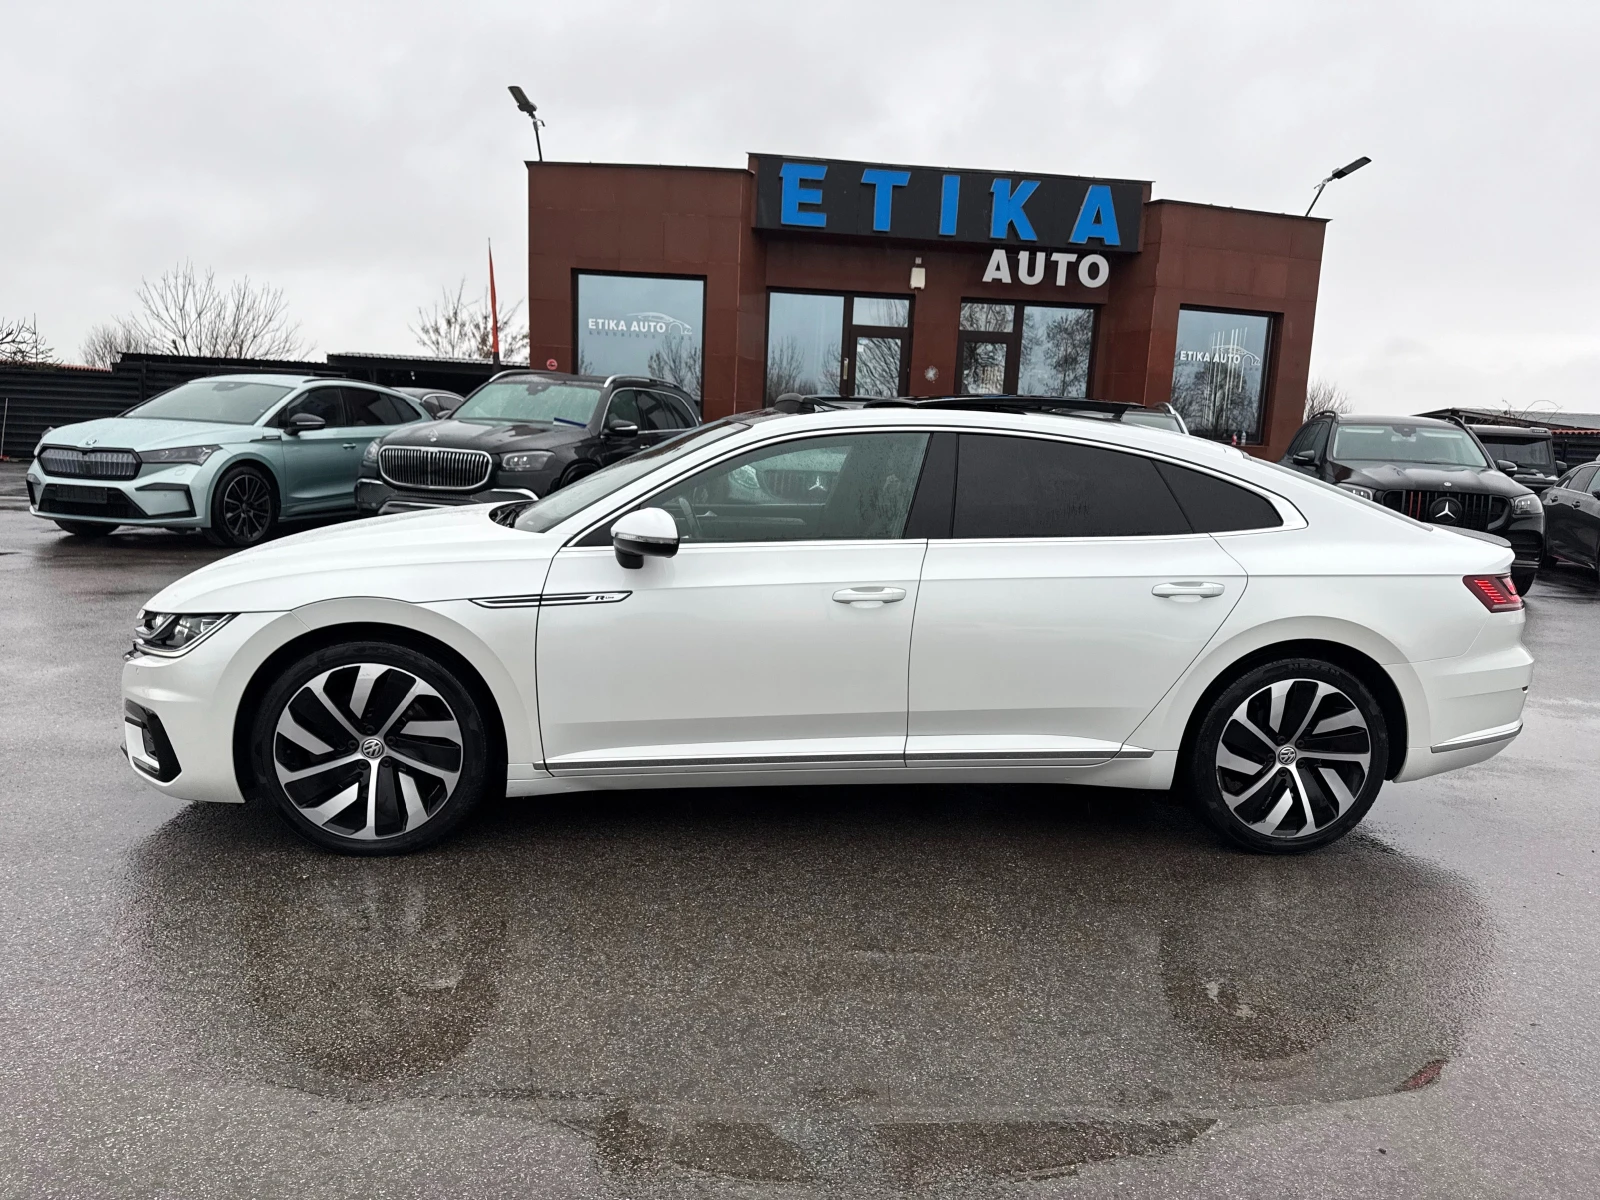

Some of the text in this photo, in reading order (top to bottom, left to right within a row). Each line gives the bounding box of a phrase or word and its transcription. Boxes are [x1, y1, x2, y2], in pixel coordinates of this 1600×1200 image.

[779, 163, 1121, 246] ETIKA
[982, 249, 1109, 288] AUTO
[588, 318, 666, 333] ETIKA AUTO
[1180, 350, 1241, 364] ETIKA AUTO
[1287, 662, 1341, 677] NEXEN
